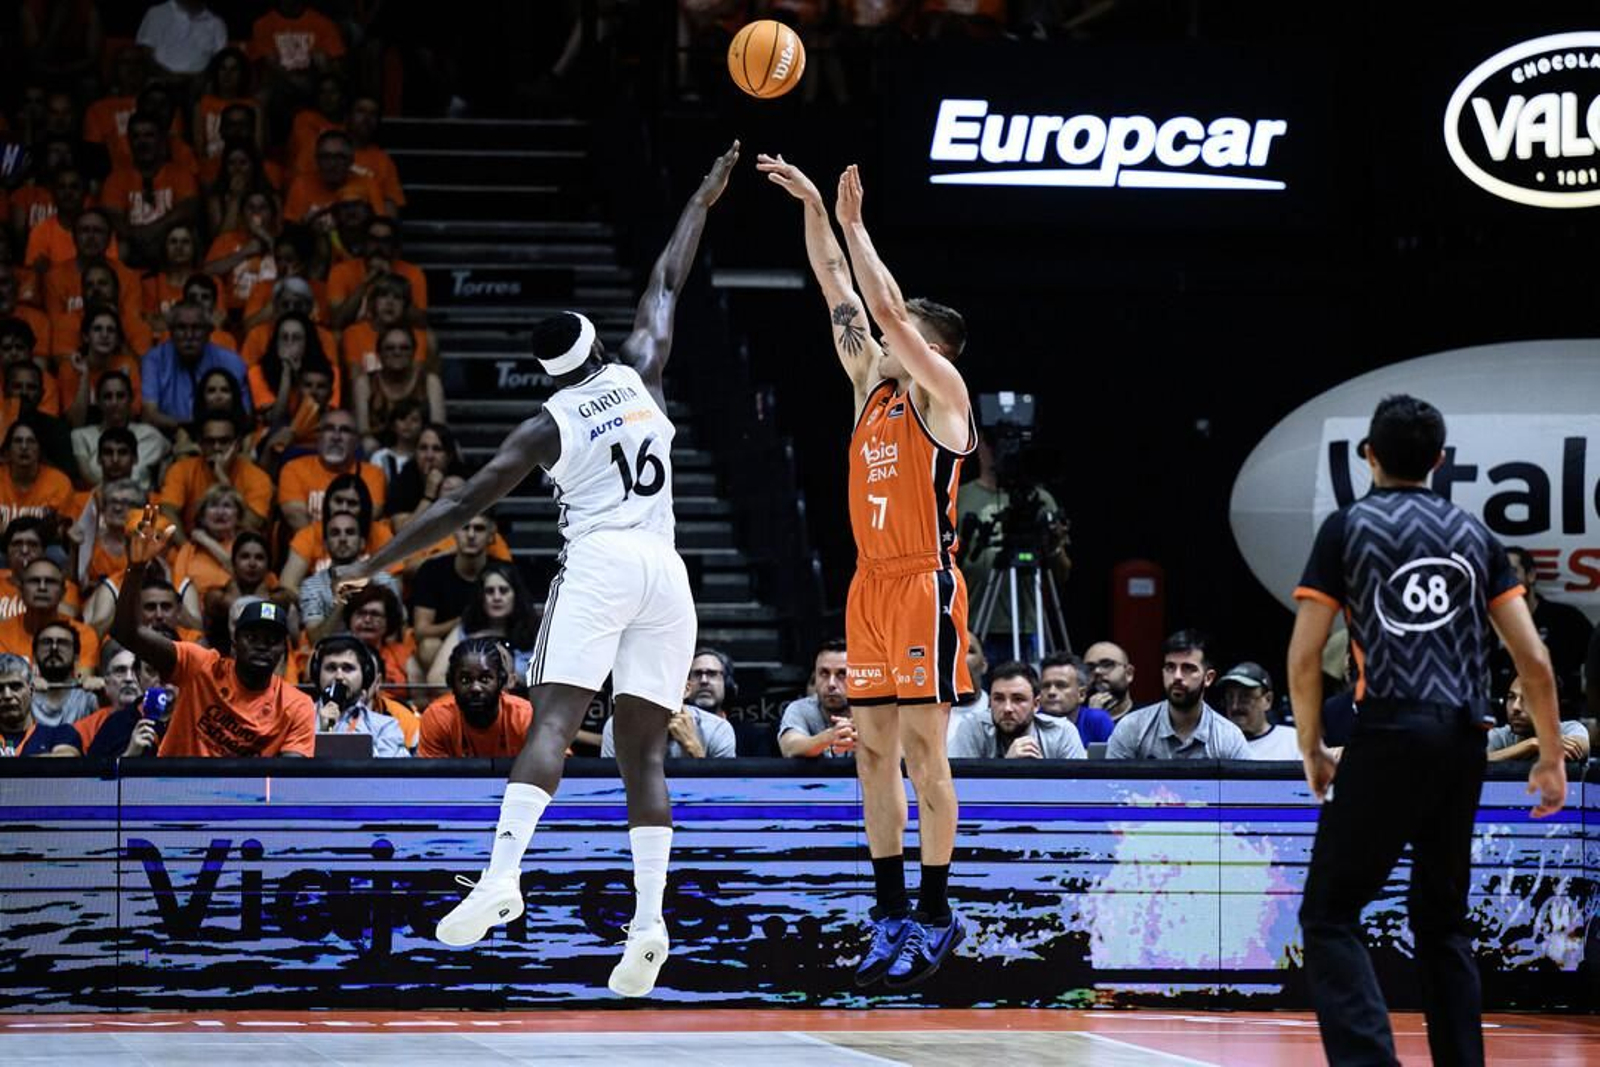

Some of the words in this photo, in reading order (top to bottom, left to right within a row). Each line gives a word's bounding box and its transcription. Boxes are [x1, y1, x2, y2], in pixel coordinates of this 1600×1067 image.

[930, 98, 1287, 187] Europcar
[450, 270, 522, 297] Torres
[495, 361, 553, 391] Torre
[610, 432, 666, 502] 16
[1328, 436, 1600, 537] Vtal
[1402, 572, 1450, 615] 68
